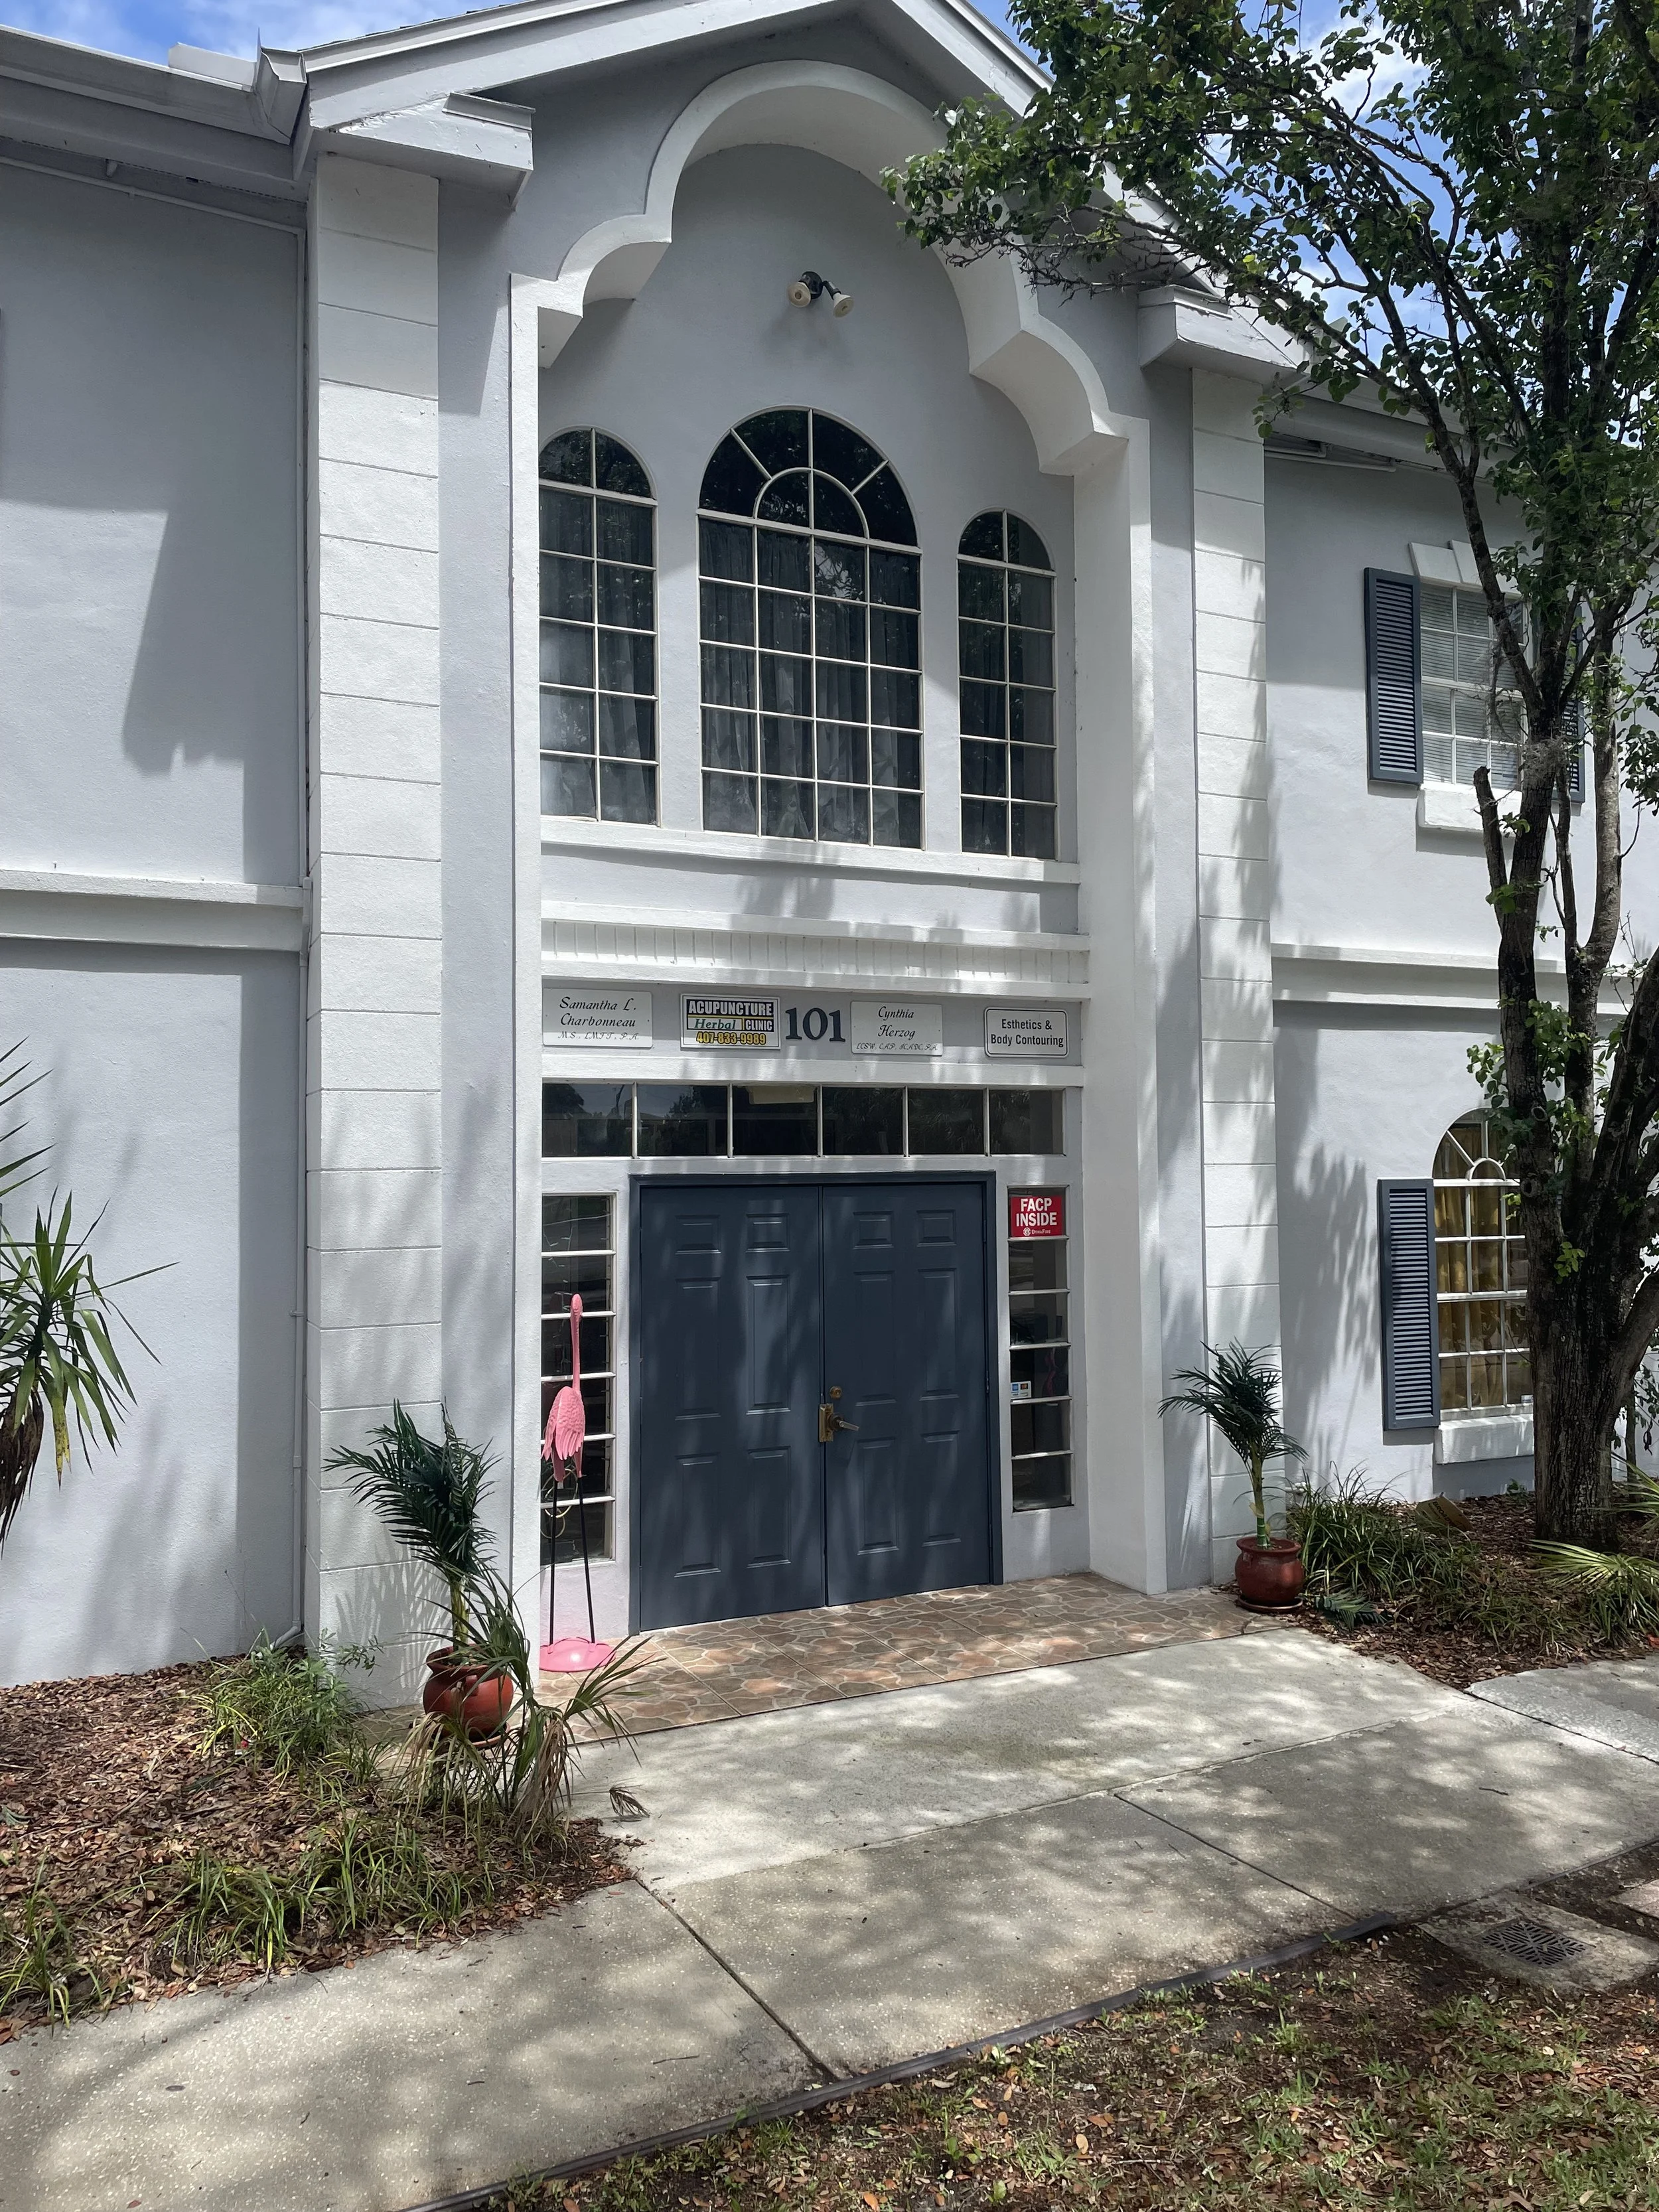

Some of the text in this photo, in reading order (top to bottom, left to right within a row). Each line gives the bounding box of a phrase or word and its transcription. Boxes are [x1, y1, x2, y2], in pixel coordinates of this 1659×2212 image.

[559, 996, 636, 1011] Samantha L.
[688, 1000, 772, 1016] ACUPUNCTURE
[561, 1013, 636, 1027] Charbonneau
[878, 1005, 914, 1021] Cynthia
[694, 1018, 772, 1031] Herbal CLINIC
[786, 1007, 846, 1042] 101
[1001, 1019, 1052, 1030] Esthetics &
[696, 1031, 766, 1045] 407-833-9989
[877, 1024, 916, 1041] Herzog
[991, 1033, 1064, 1048] Body Contouring
[1021, 1198, 1052, 1212] FACP
[1016, 1212, 1057, 1227] INSIDE
